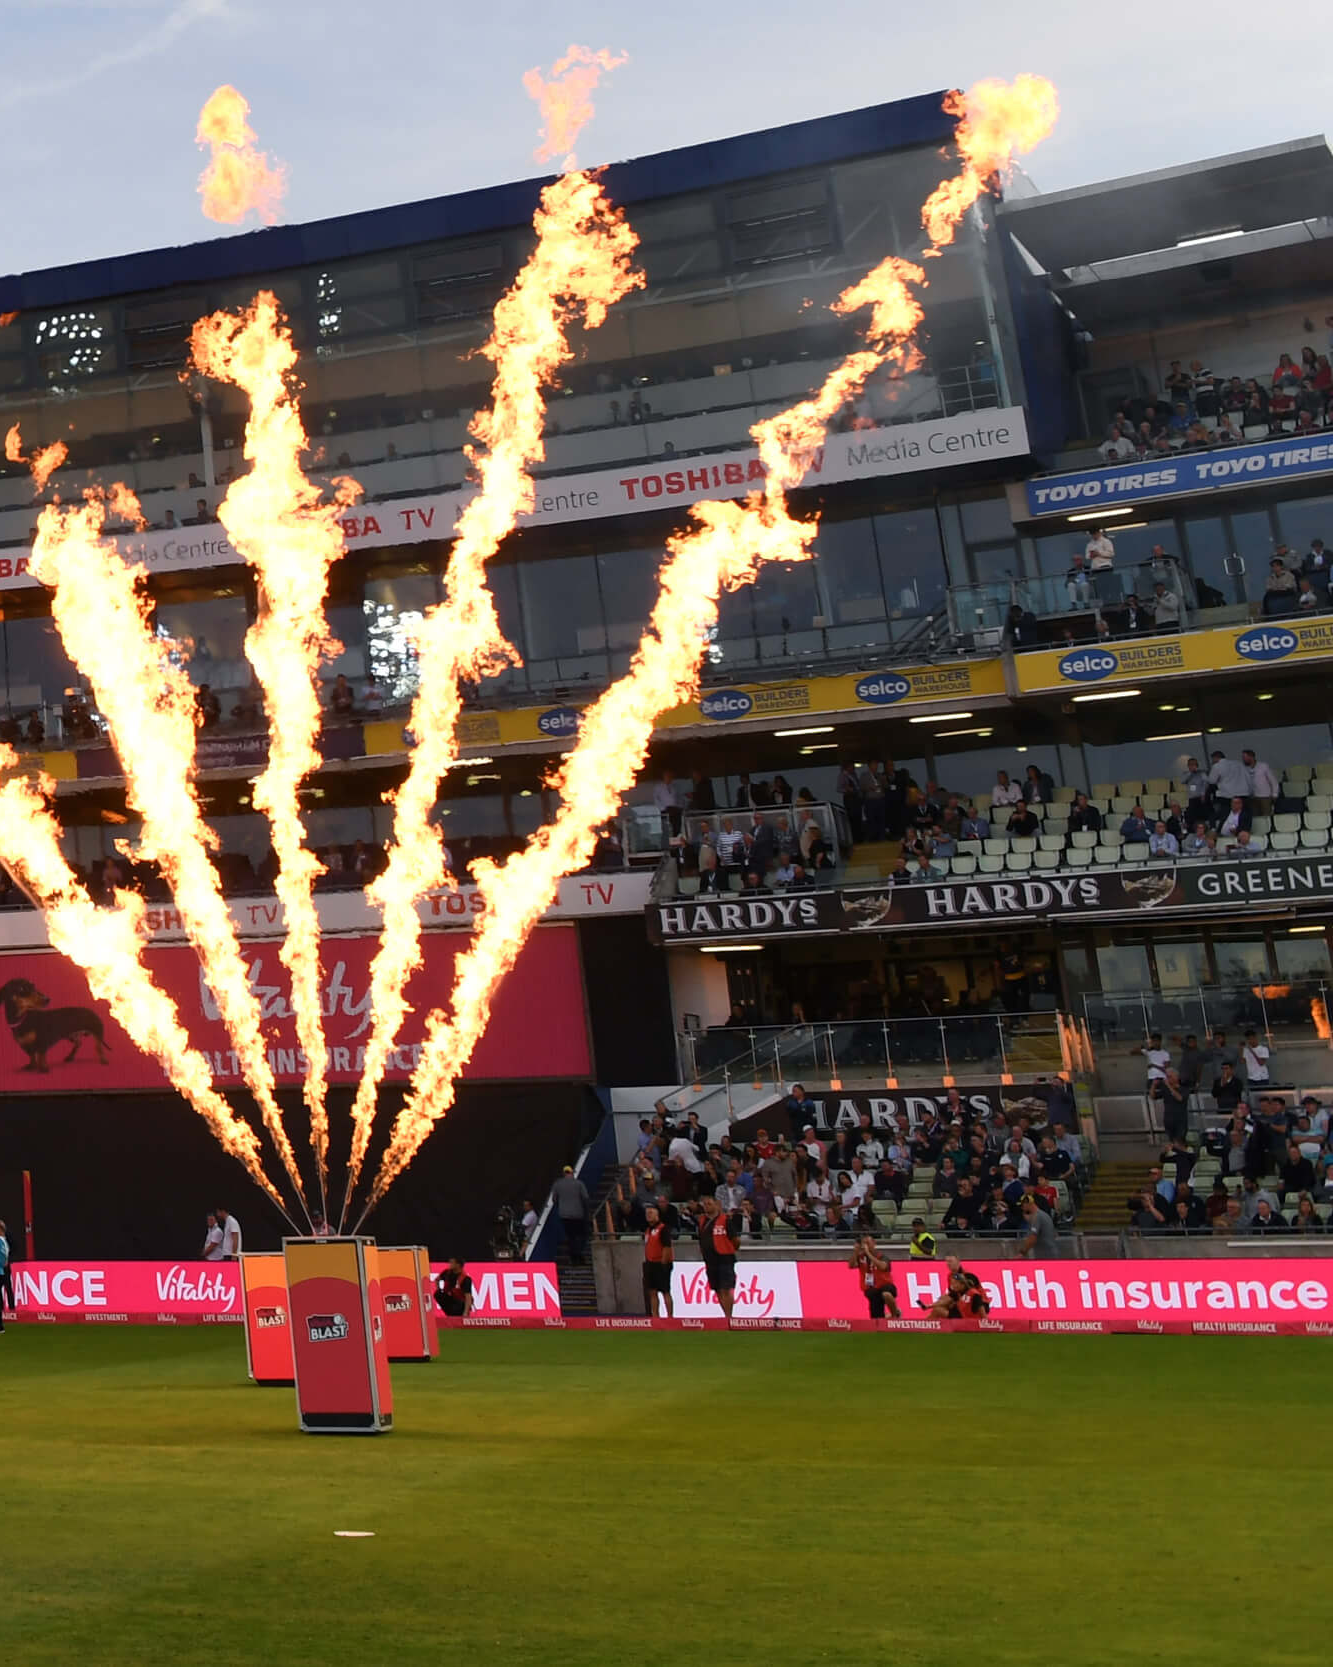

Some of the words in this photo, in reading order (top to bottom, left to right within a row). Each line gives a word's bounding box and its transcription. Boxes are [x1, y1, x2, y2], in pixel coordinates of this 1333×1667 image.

[846, 437, 921, 466] Media
[928, 427, 1010, 455] Centre
[1196, 455, 1266, 479] TOYO
[620, 459, 768, 500] TOSHIBA
[1035, 480, 1101, 504] TOYO
[1103, 468, 1177, 493] TIRES
[535, 491, 599, 514] entre
[400, 507, 434, 531] TV
[164, 540, 229, 560] Centre
[1119, 644, 1182, 662] BUILDERS
[1238, 634, 1294, 653] selco
[1062, 656, 1115, 674] selco
[1121, 655, 1183, 670] WAREHOUSE
[859, 680, 908, 696] selco
[912, 670, 970, 686] BUILDERS
[701, 697, 750, 713] selco
[754, 688, 810, 701] BUILDERS
[540, 714, 582, 731] selc
[1198, 864, 1333, 896] GREENE
[580, 883, 614, 905] TV
[925, 878, 1101, 916] HARDYS
[247, 904, 278, 925] TV
[659, 898, 818, 934] HARDYS
[156, 1265, 236, 1312] Vitality
[906, 1269, 1067, 1309] Halth
[1078, 1269, 1330, 1310] insurance
[386, 1302, 411, 1311] BLAST
[85, 1313, 128, 1322] INVESTMENTS
[202, 1313, 216, 1322] LIFE
[258, 1315, 286, 1328] BLAST
[596, 1319, 610, 1327] LIFE
[611, 1319, 652, 1328] INSURANCE
[730, 1318, 758, 1328] HEALTH
[887, 1319, 941, 1330] INVESTMENTS
[1038, 1321, 1055, 1331] LIFE
[1056, 1321, 1103, 1331] INSURANCE
[1193, 1322, 1223, 1332] HEALTH
[1227, 1322, 1277, 1333] INSURANCE
[311, 1325, 347, 1341] BLAST
